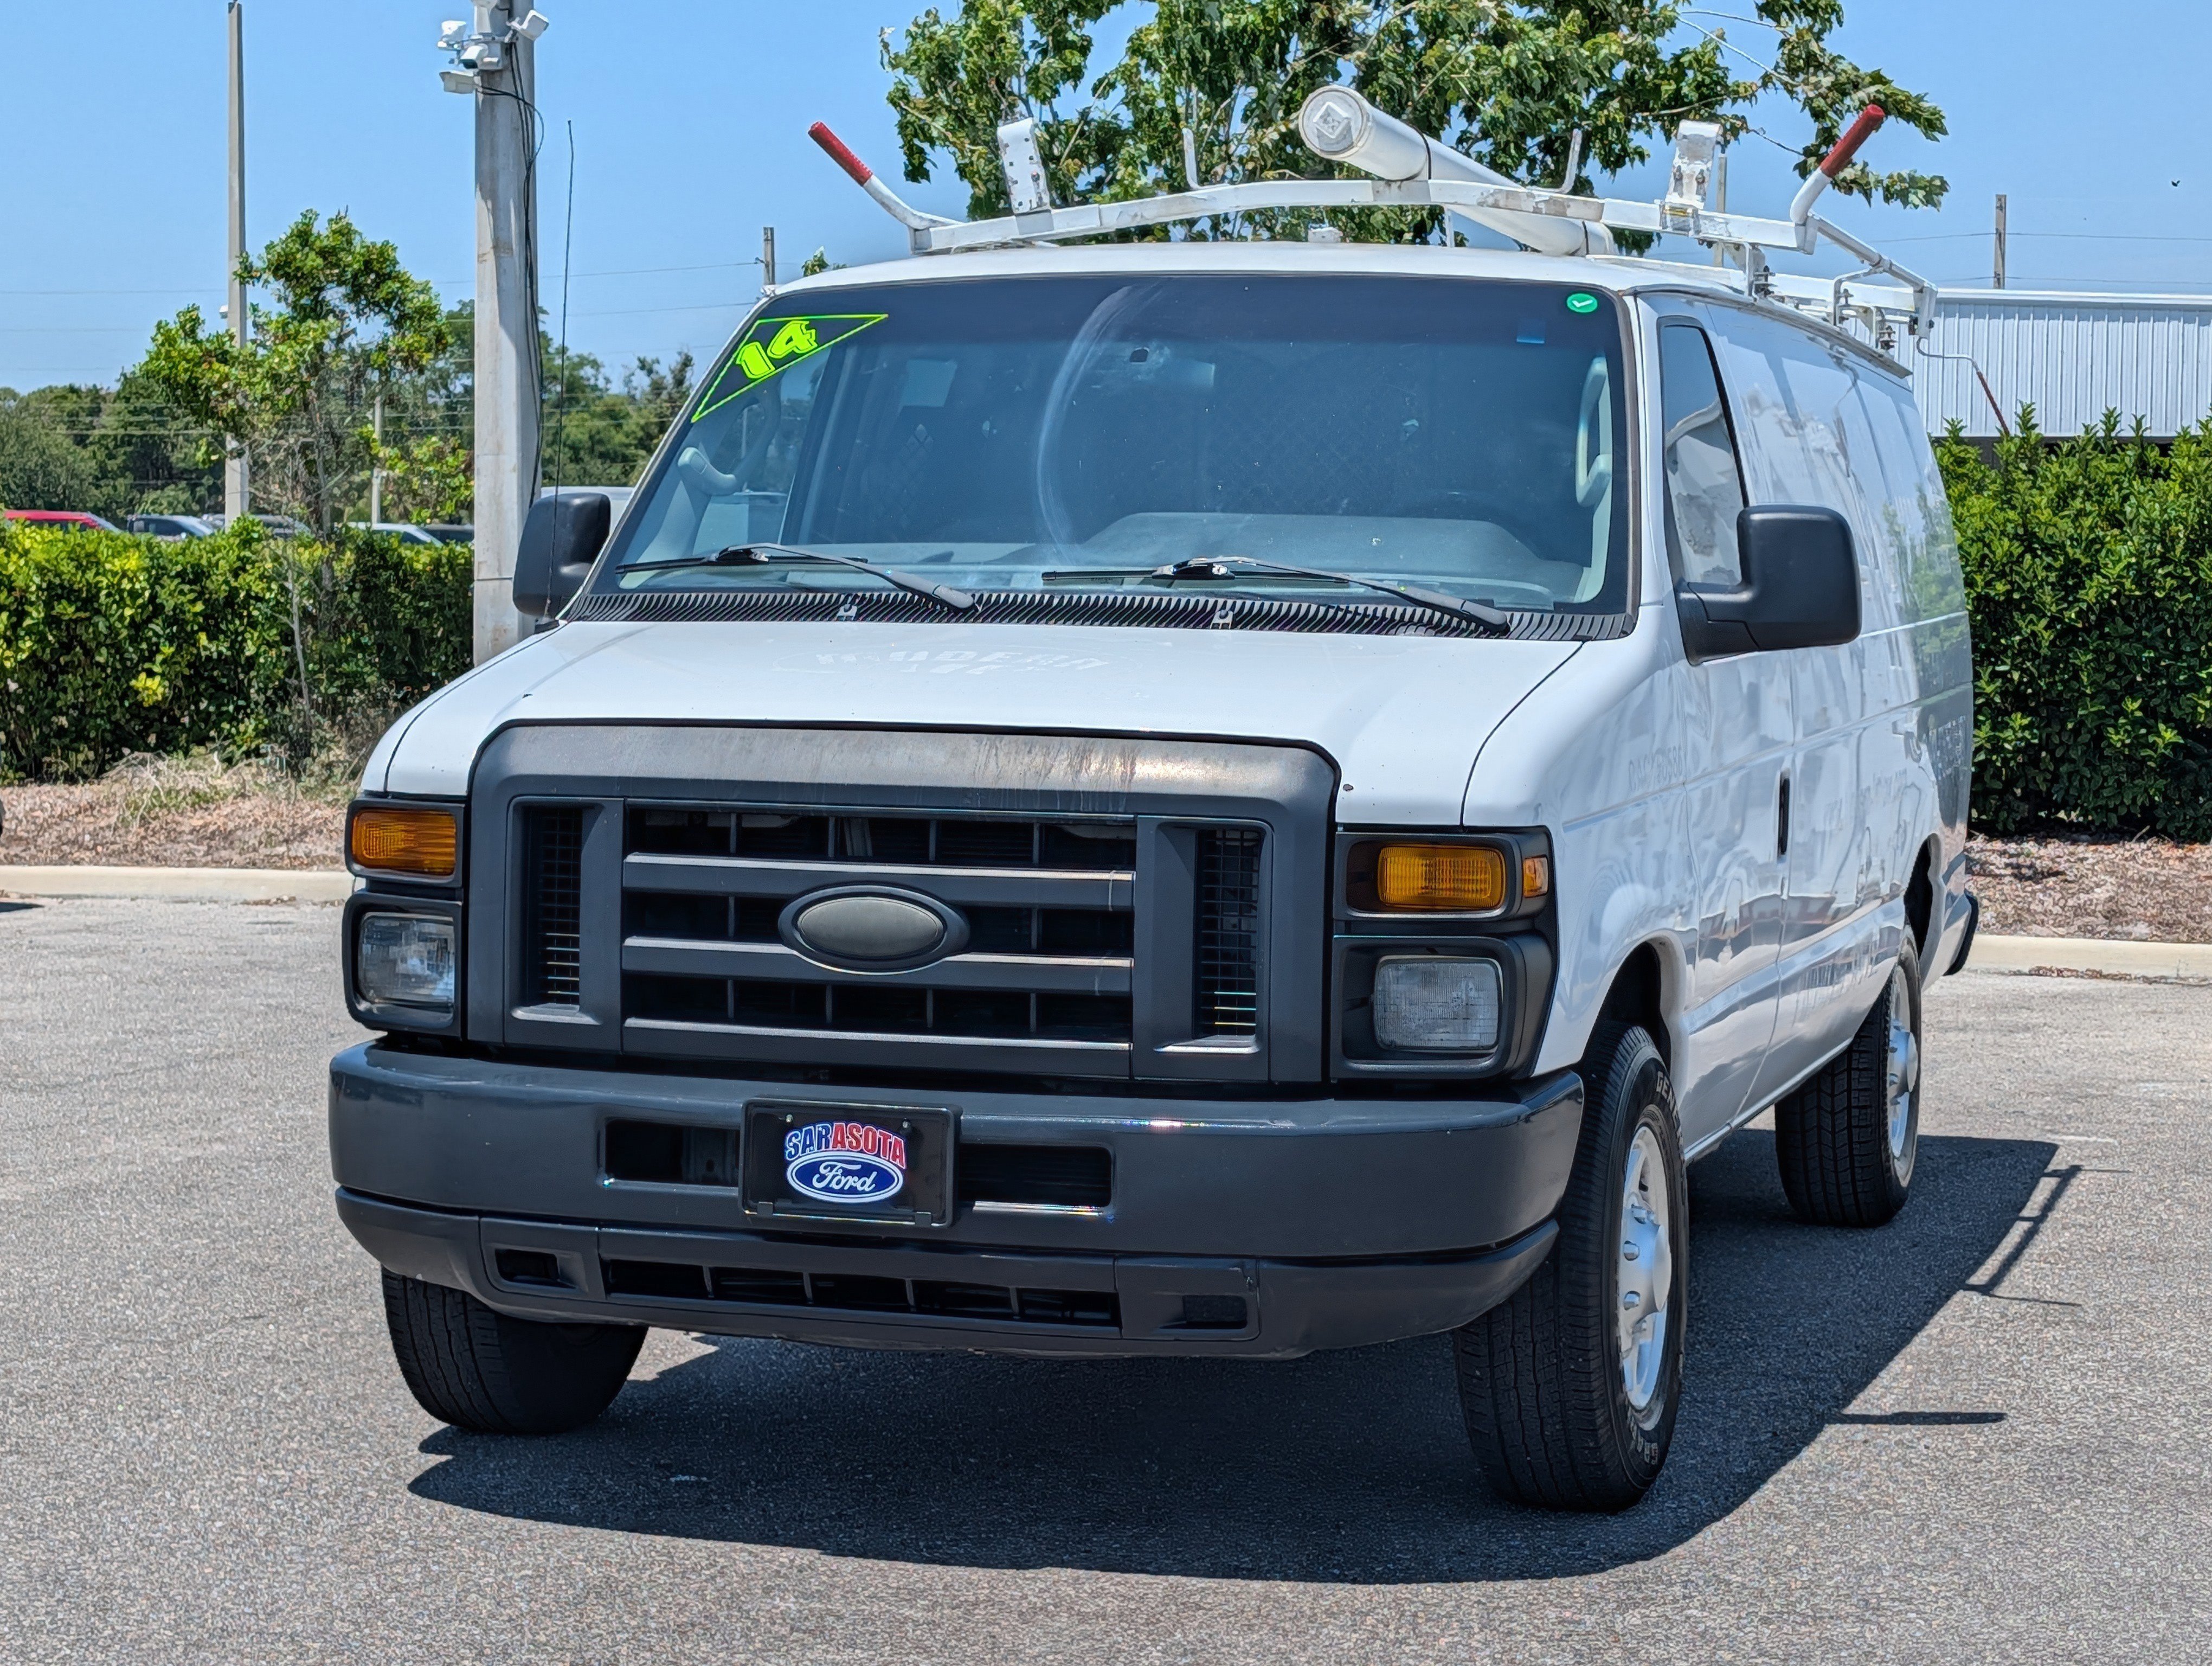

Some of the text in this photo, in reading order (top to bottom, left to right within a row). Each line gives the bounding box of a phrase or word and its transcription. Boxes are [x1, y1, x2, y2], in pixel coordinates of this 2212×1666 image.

[736, 320, 818, 379] 14
[785, 1121, 906, 1169] SARASOTA
[813, 1161, 876, 1191] Ford
